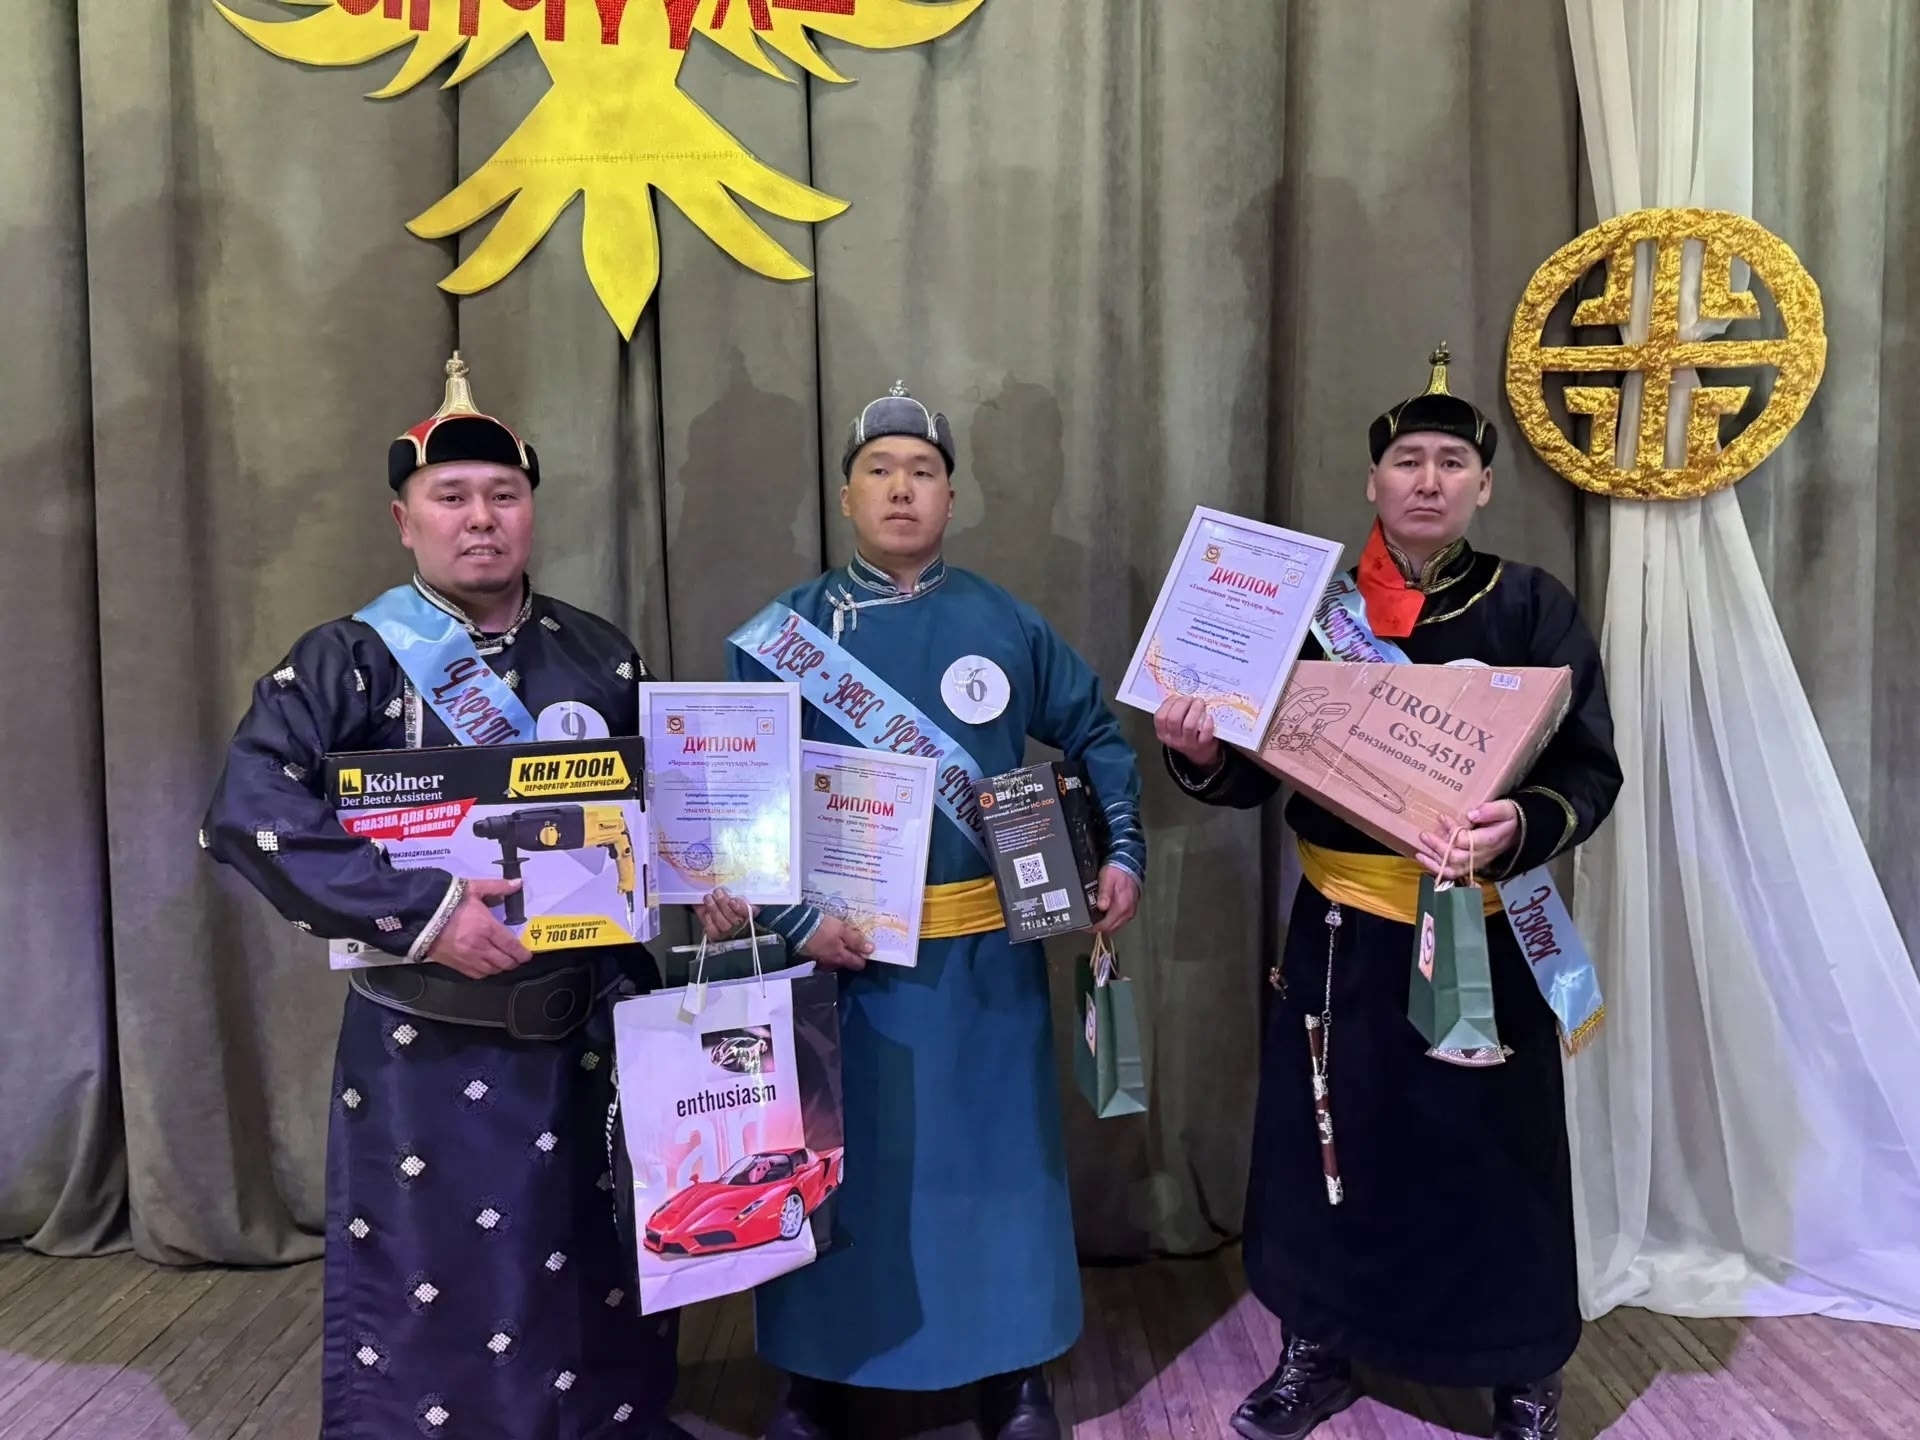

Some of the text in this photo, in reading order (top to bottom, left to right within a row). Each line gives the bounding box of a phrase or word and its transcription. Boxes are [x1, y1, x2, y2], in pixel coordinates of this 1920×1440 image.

[1208, 566, 1280, 599] ДИПЛОМ
[757, 615, 825, 679] ЭКЕР
[823, 672, 884, 729] ЭРЕС
[966, 667, 988, 702] 6
[561, 712, 587, 740] 9
[1368, 680, 1494, 753] EUROLUX
[683, 736, 756, 754] ДИПЛОМ
[1348, 724, 1464, 792] Бензиновая пила
[1388, 722, 1476, 776] GS-4518
[364, 772, 444, 794] Kölner
[518, 757, 616, 783] KRH 700H
[524, 776, 624, 792] ПЕРФОРАТОР ЭЛЕКТРИЧЕСКИЙ
[341, 791, 443, 807] Der Beste Assistent
[827, 793, 895, 817] ДИПЛОМ
[353, 803, 461, 833] СМАЗКА ДЛЯ БУРОВ
[410, 819, 456, 834] КОМПЛЕКТЕ
[389, 848, 451, 859] РОИЗВОДИТЕЛЬНОСТЬ
[546, 927, 599, 943] 700 ВАТТ
[677, 1084, 776, 1117] enthusiasm
